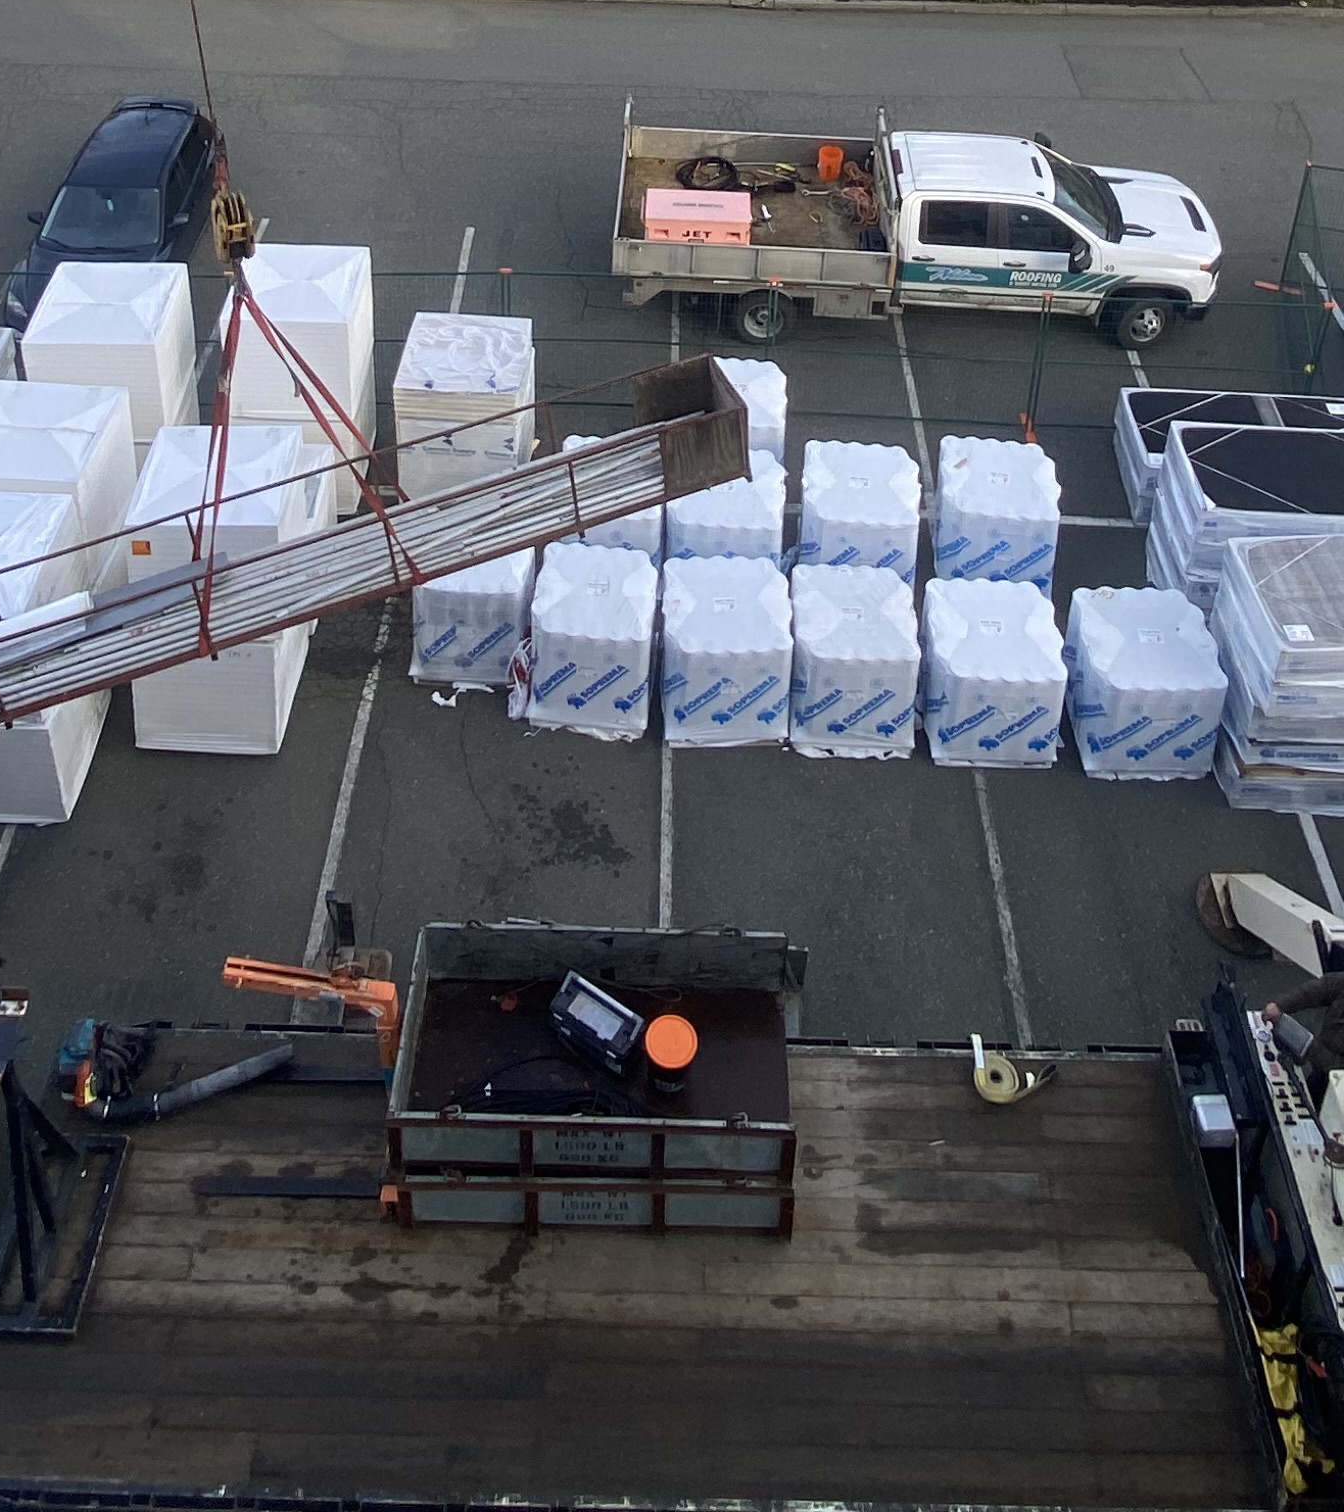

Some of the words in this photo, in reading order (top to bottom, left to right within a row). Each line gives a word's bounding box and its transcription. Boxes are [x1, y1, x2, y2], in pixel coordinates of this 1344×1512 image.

[681, 230, 712, 238] JET
[1009, 270, 1062, 284] ROOFING
[961, 539, 1008, 571] SOPREMA
[1003, 543, 1052, 576] SOPREMA
[467, 621, 513, 659] SOPREMA
[580, 664, 626, 698] SOPREMA
[682, 677, 732, 712] SOPREMA
[727, 675, 778, 713] SOPREMA
[842, 688, 893, 724] SOPREMA
[945, 704, 996, 736] SOPREMA
[995, 705, 1047, 740] SOPREMA
[1097, 715, 1152, 746] SOPREMA
[1144, 713, 1202, 750] SOPREMA
